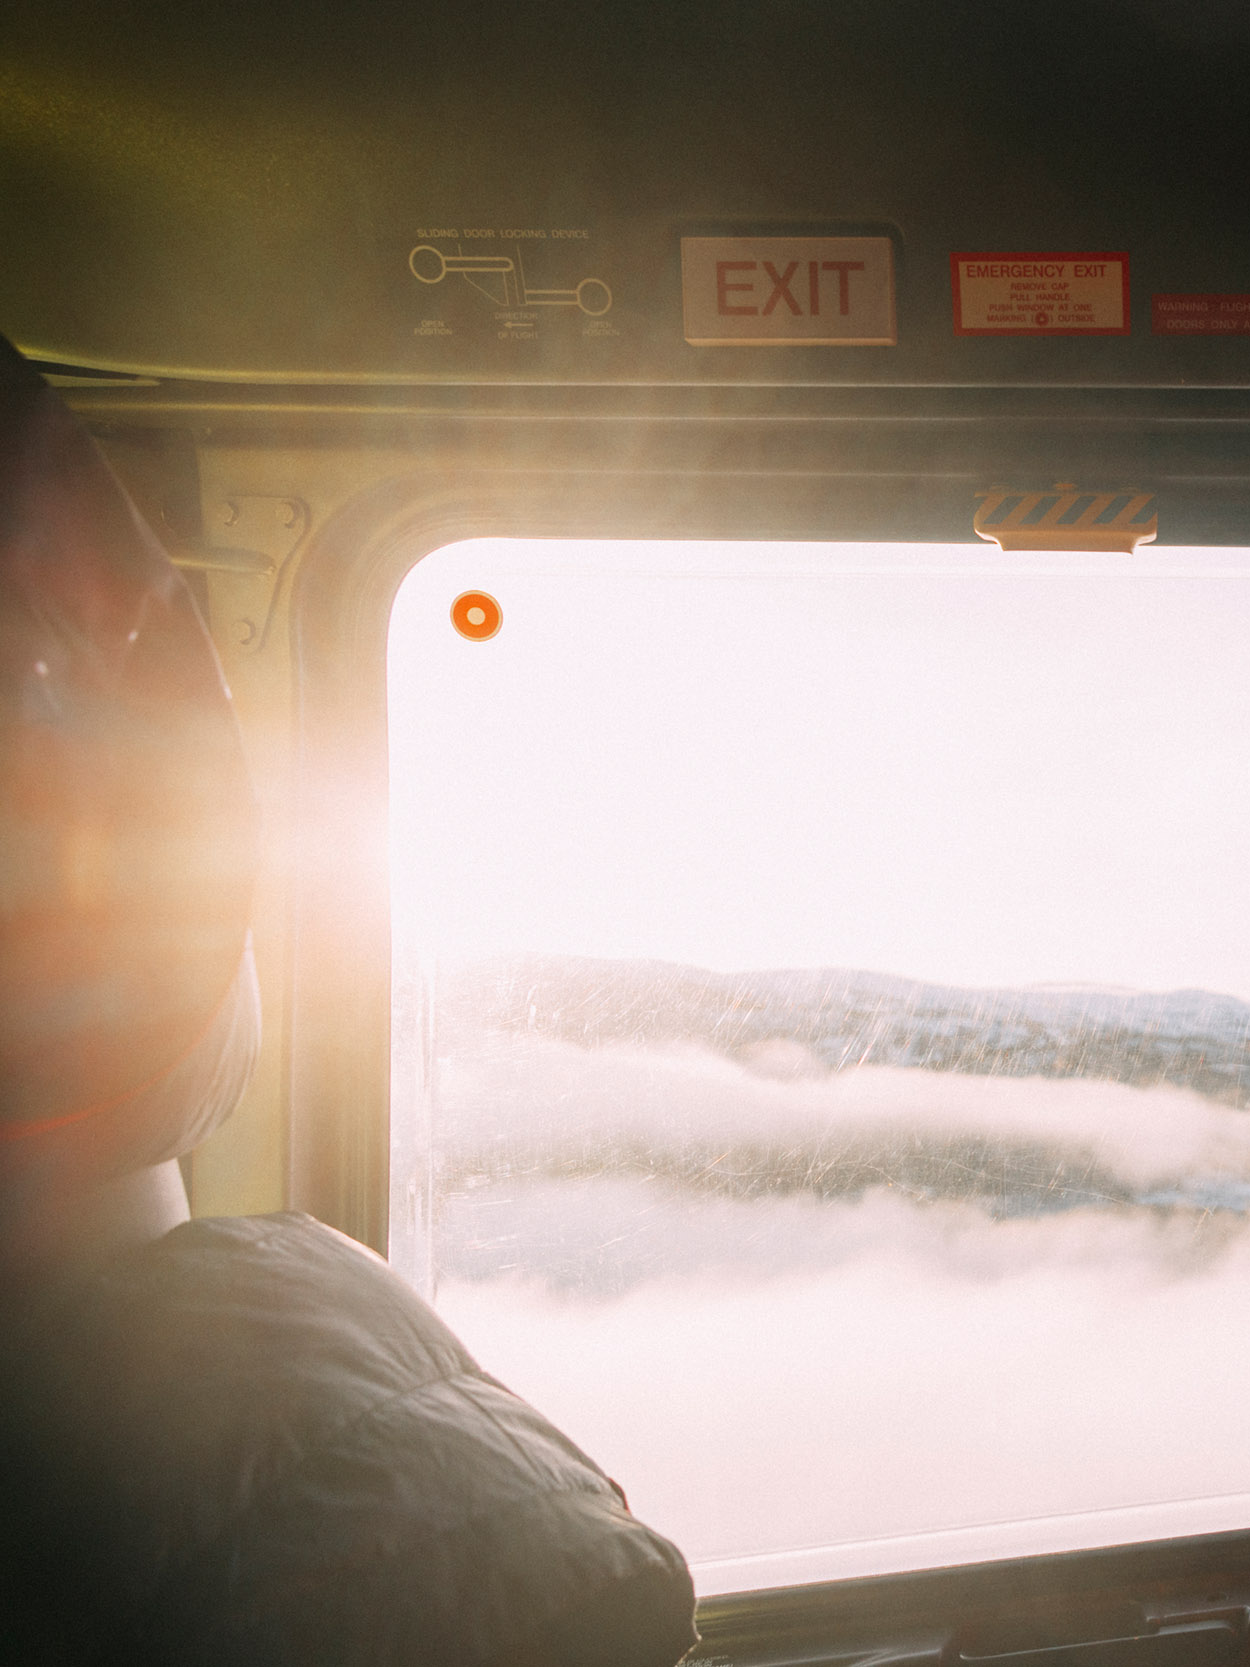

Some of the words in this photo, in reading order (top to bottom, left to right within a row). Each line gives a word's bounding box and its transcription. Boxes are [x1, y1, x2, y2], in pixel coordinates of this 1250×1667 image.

[417, 229, 459, 239] SLIDING
[464, 229, 495, 239] DOOR
[500, 229, 547, 239] LOCKING
[552, 229, 589, 239] DEVICE
[966, 264, 1065, 278] EMERGENCY
[1074, 264, 1107, 278] EXIT
[716, 261, 865, 316] EXIT
[1010, 282, 1047, 291] REMOVE
[1051, 282, 1070, 291] CAP
[1010, 293, 1031, 301] PULL
[989, 304, 1013, 312] PUSH
[1017, 304, 1054, 312] WINDOW
[1058, 304, 1070, 312] AT
[1074, 304, 1093, 312] ONE
[494, 312, 538, 320] DIRECTION
[986, 314, 1026, 322] MARKING
[1167, 319, 1205, 329] DOORS
[1210, 319, 1238, 329] ONLY
